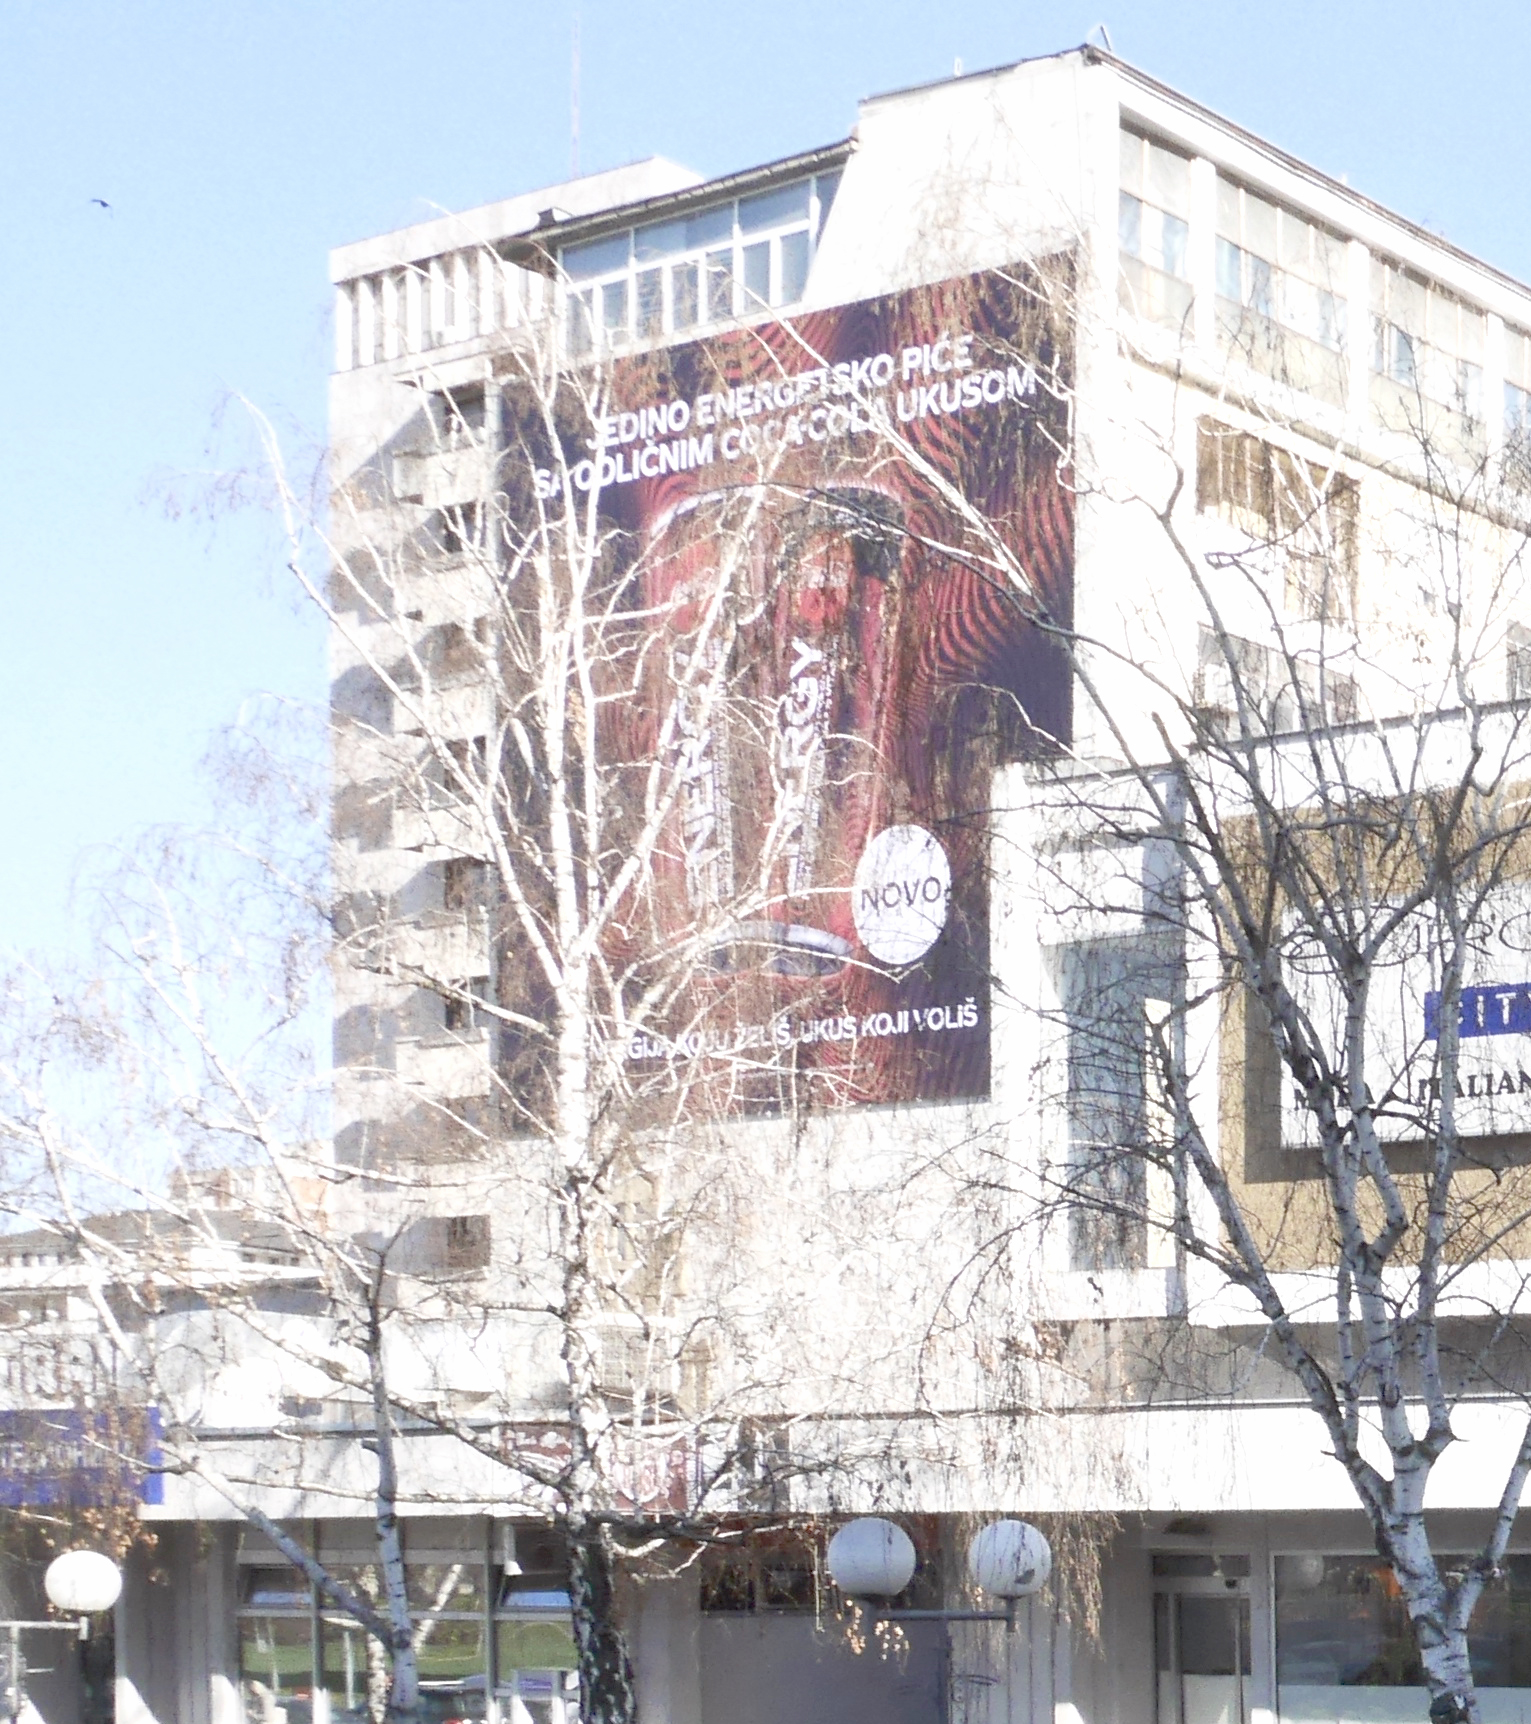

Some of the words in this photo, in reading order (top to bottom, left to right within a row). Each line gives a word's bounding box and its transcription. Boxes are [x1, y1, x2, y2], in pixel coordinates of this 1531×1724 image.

[575, 434, 714, 492] ODLIČNIM
[897, 363, 1036, 422] UKUSOM
[586, 400, 690, 450] JEDINO
[902, 332, 973, 380] PIĆE
[861, 876, 941, 915] NOVO
[861, 1010, 909, 1037] KOJI
[912, 996, 978, 1031] VOLIŠ
